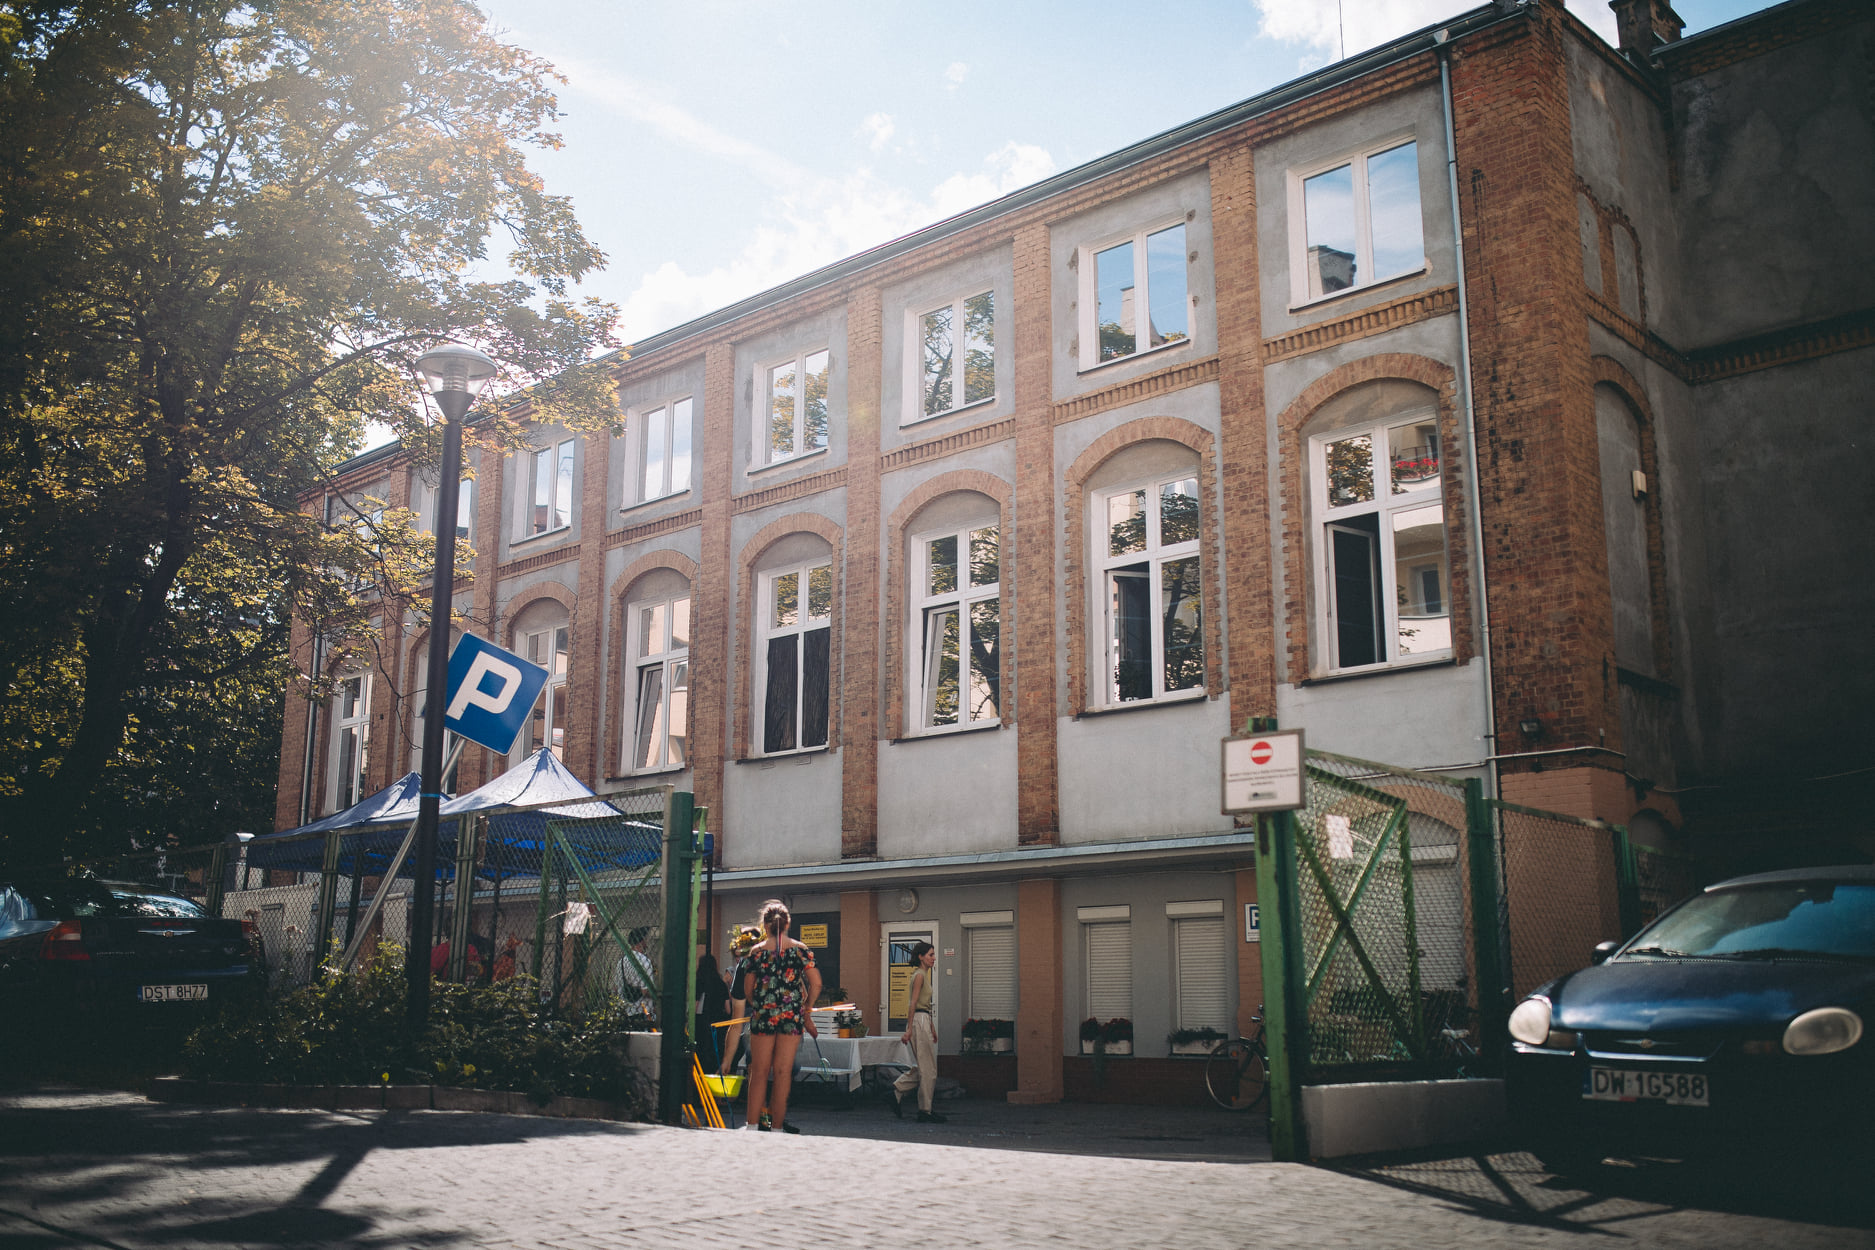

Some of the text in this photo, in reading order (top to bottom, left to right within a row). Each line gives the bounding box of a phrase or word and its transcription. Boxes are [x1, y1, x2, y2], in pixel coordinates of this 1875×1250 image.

[446, 651, 522, 720] P
[144, 985, 206, 999] DST 8H77
[1594, 1070, 1705, 1099] DW 1G588
